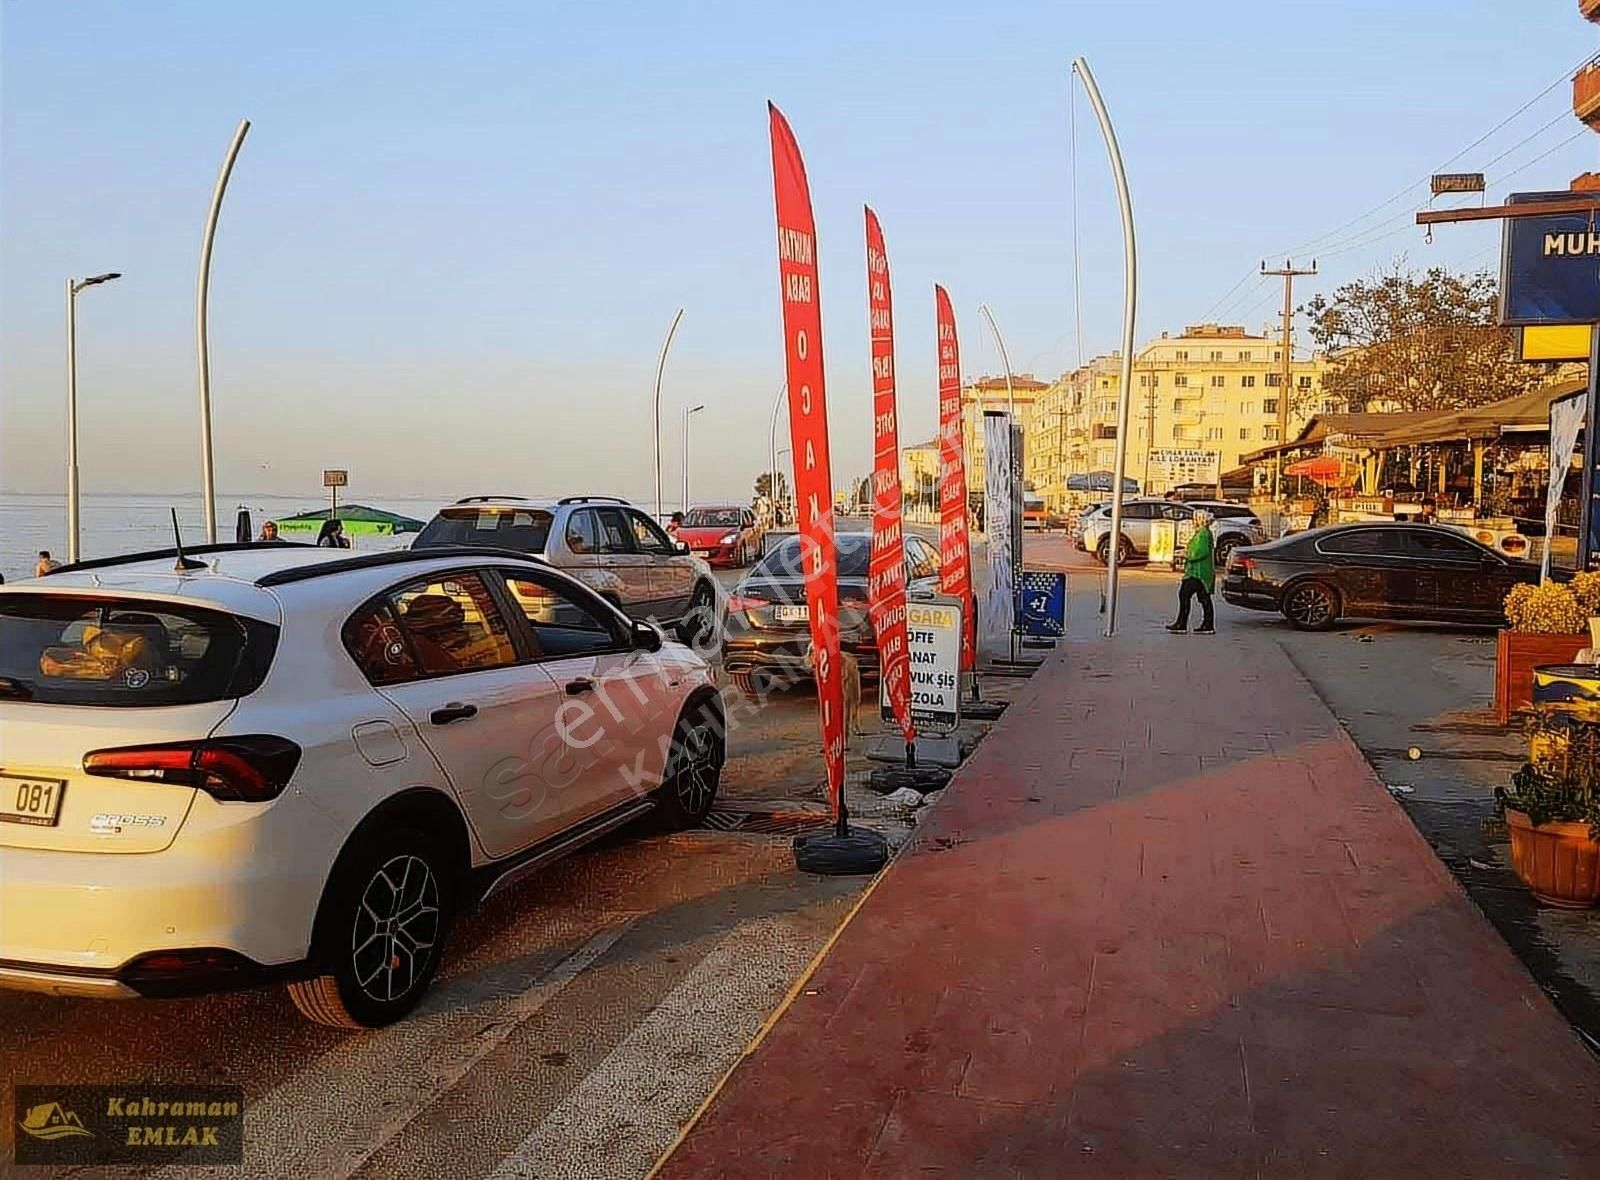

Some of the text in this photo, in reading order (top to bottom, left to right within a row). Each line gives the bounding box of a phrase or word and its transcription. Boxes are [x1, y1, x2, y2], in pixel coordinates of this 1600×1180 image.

[1544, 232, 1600, 256] MUH
[909, 609, 953, 625] GARA
[907, 628, 934, 644] ÖFTE
[910, 671, 934, 685] VUK
[937, 671, 955, 690] ŞİŞ
[911, 692, 945, 706] ZOLA
[16, 783, 53, 815] 081
